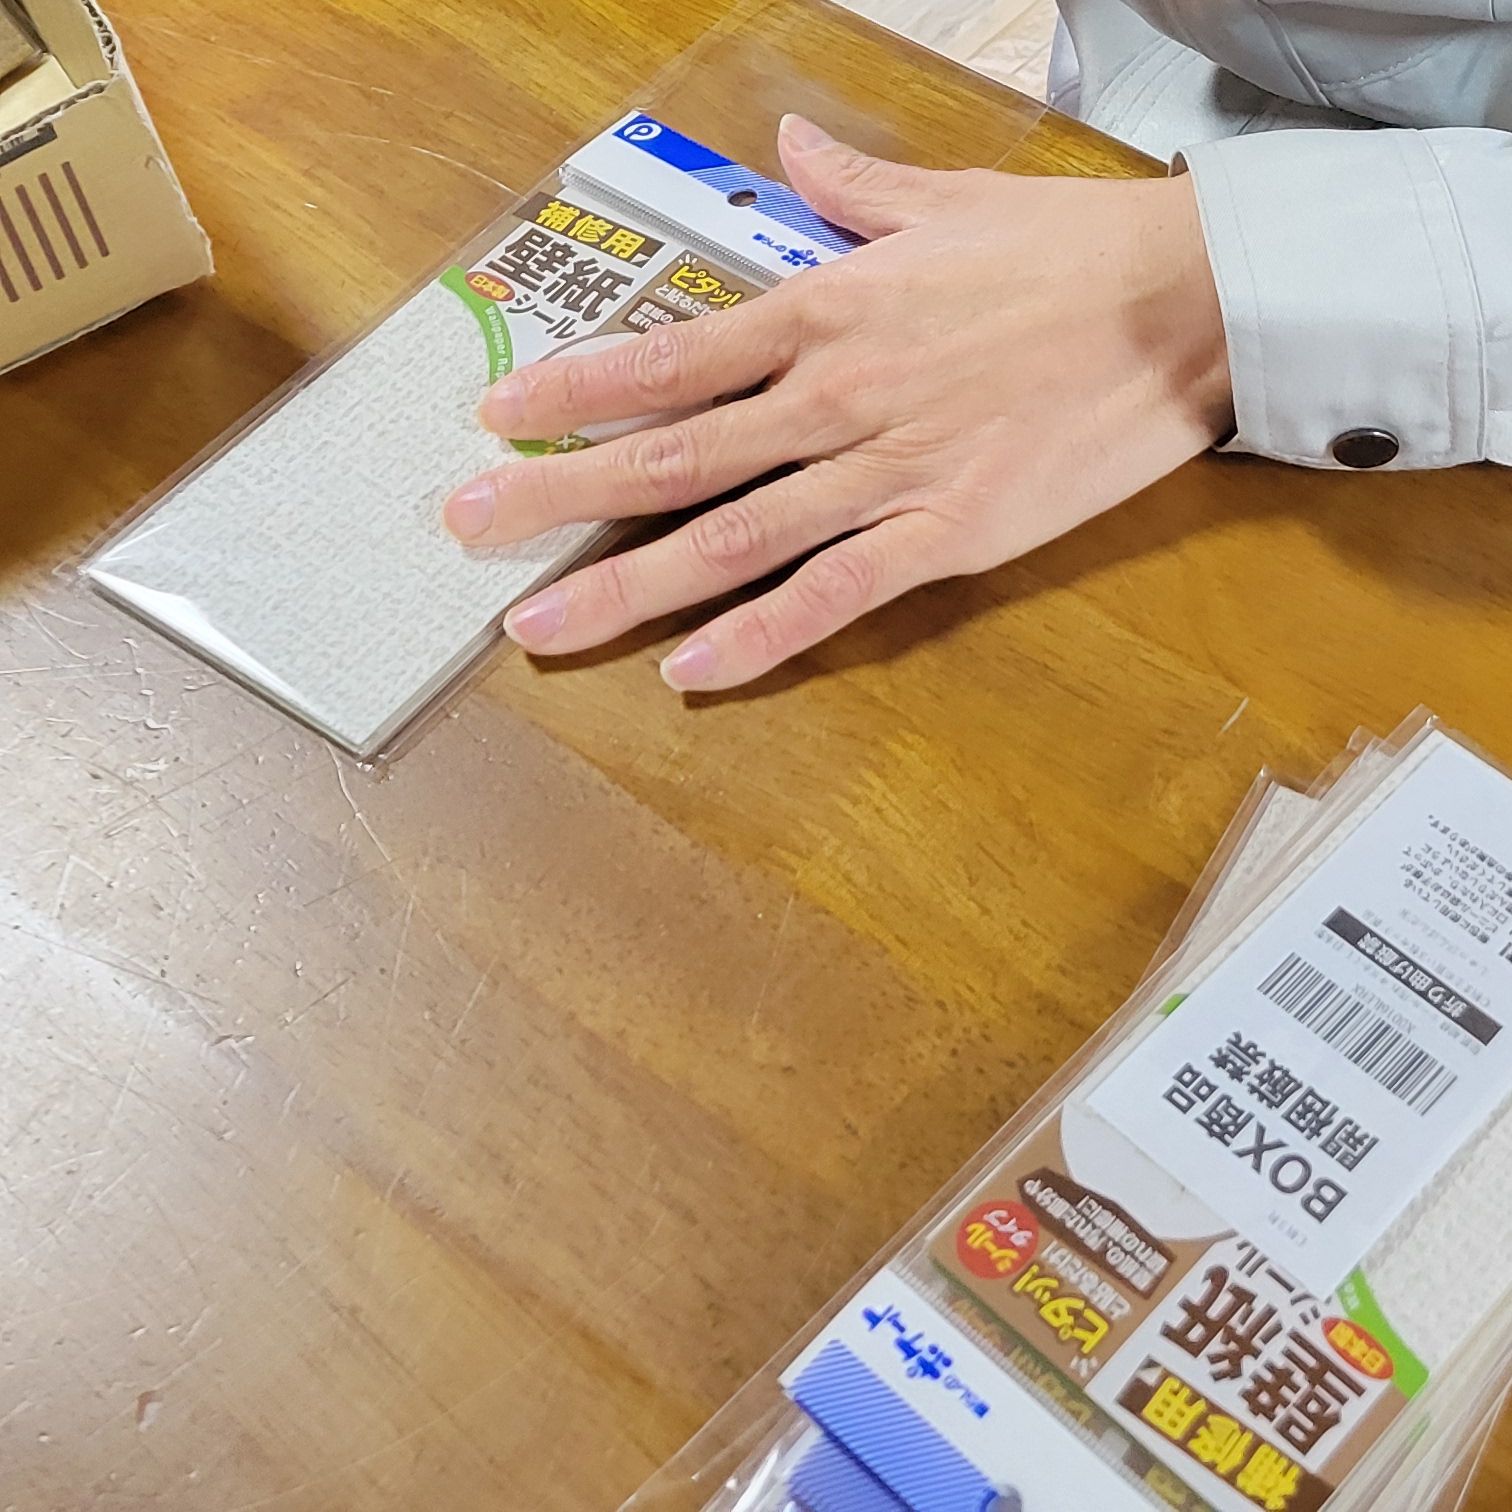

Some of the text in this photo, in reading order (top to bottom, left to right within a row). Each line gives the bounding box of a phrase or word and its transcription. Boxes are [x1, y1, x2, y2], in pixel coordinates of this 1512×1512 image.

[535, 200, 646, 259] 補修用
[469, 274, 511, 299] 日本製
[485, 227, 635, 321] 壁紙
[670, 264, 742, 308] ピタッ!
[484, 305, 507, 356] Wallpaper
[505, 293, 578, 339] シール
[1356, 930, 1467, 1019] 折り曲げ厳禁
[1209, 1030, 1381, 1172] 開梱厳禁
[1162, 1061, 1350, 1224] BOX商品
[967, 1222, 1019, 1277] シール
[981, 1207, 1035, 1249] タイプ
[1012, 1260, 1111, 1357] ピタッ!
[1042, 1240, 1129, 1320] と貼るだけ!
[1236, 1238, 1321, 1326] シール
[857, 1302, 955, 1385] ポケット
[1160, 1262, 1369, 1456] 壁紙
[1332, 1320, 1388, 1375] 日本製
[1142, 1378, 1300, 1511] 補修用
